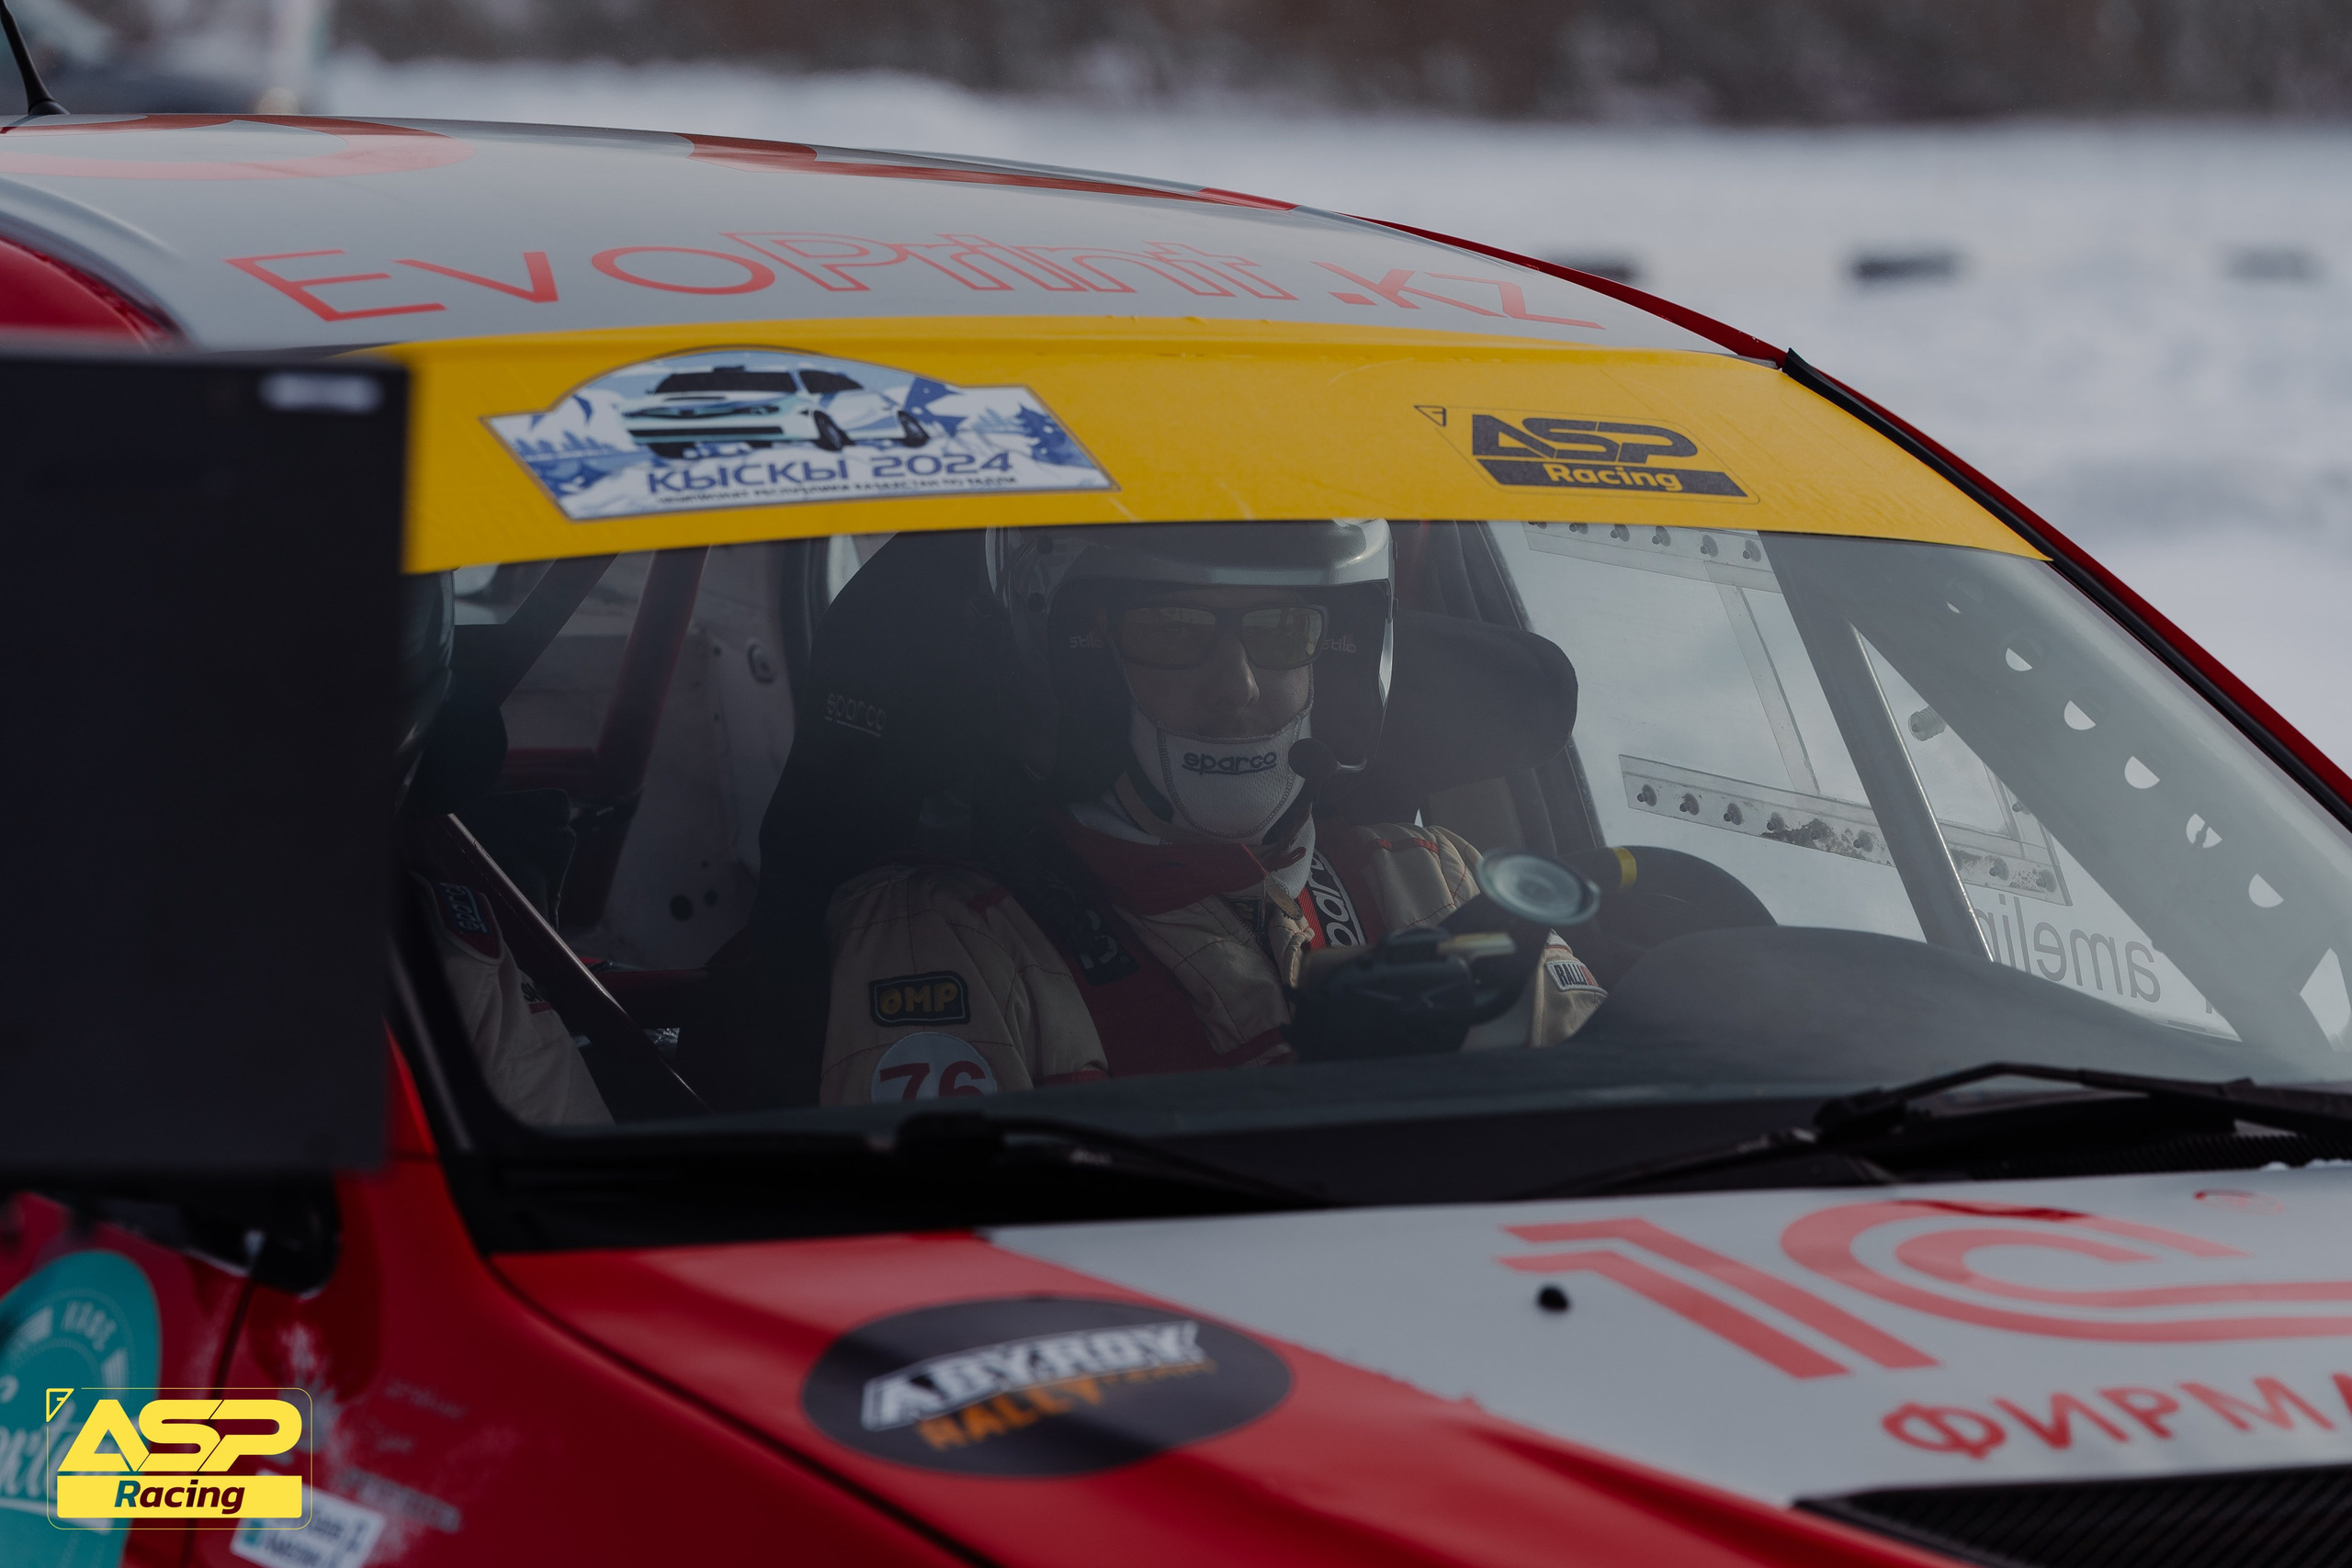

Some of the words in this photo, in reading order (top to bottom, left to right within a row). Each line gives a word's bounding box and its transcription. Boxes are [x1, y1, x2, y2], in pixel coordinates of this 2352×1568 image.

[1472, 413, 1698, 464] ASP
[648, 459, 848, 493] КЫСКЫ
[872, 450, 1013, 478] 2024
[1544, 463, 1682, 491] Racing
[825, 692, 887, 736] sparco
[1182, 751, 1277, 776] sparco
[879, 981, 958, 1015] OMP
[879, 1060, 986, 1102] 76
